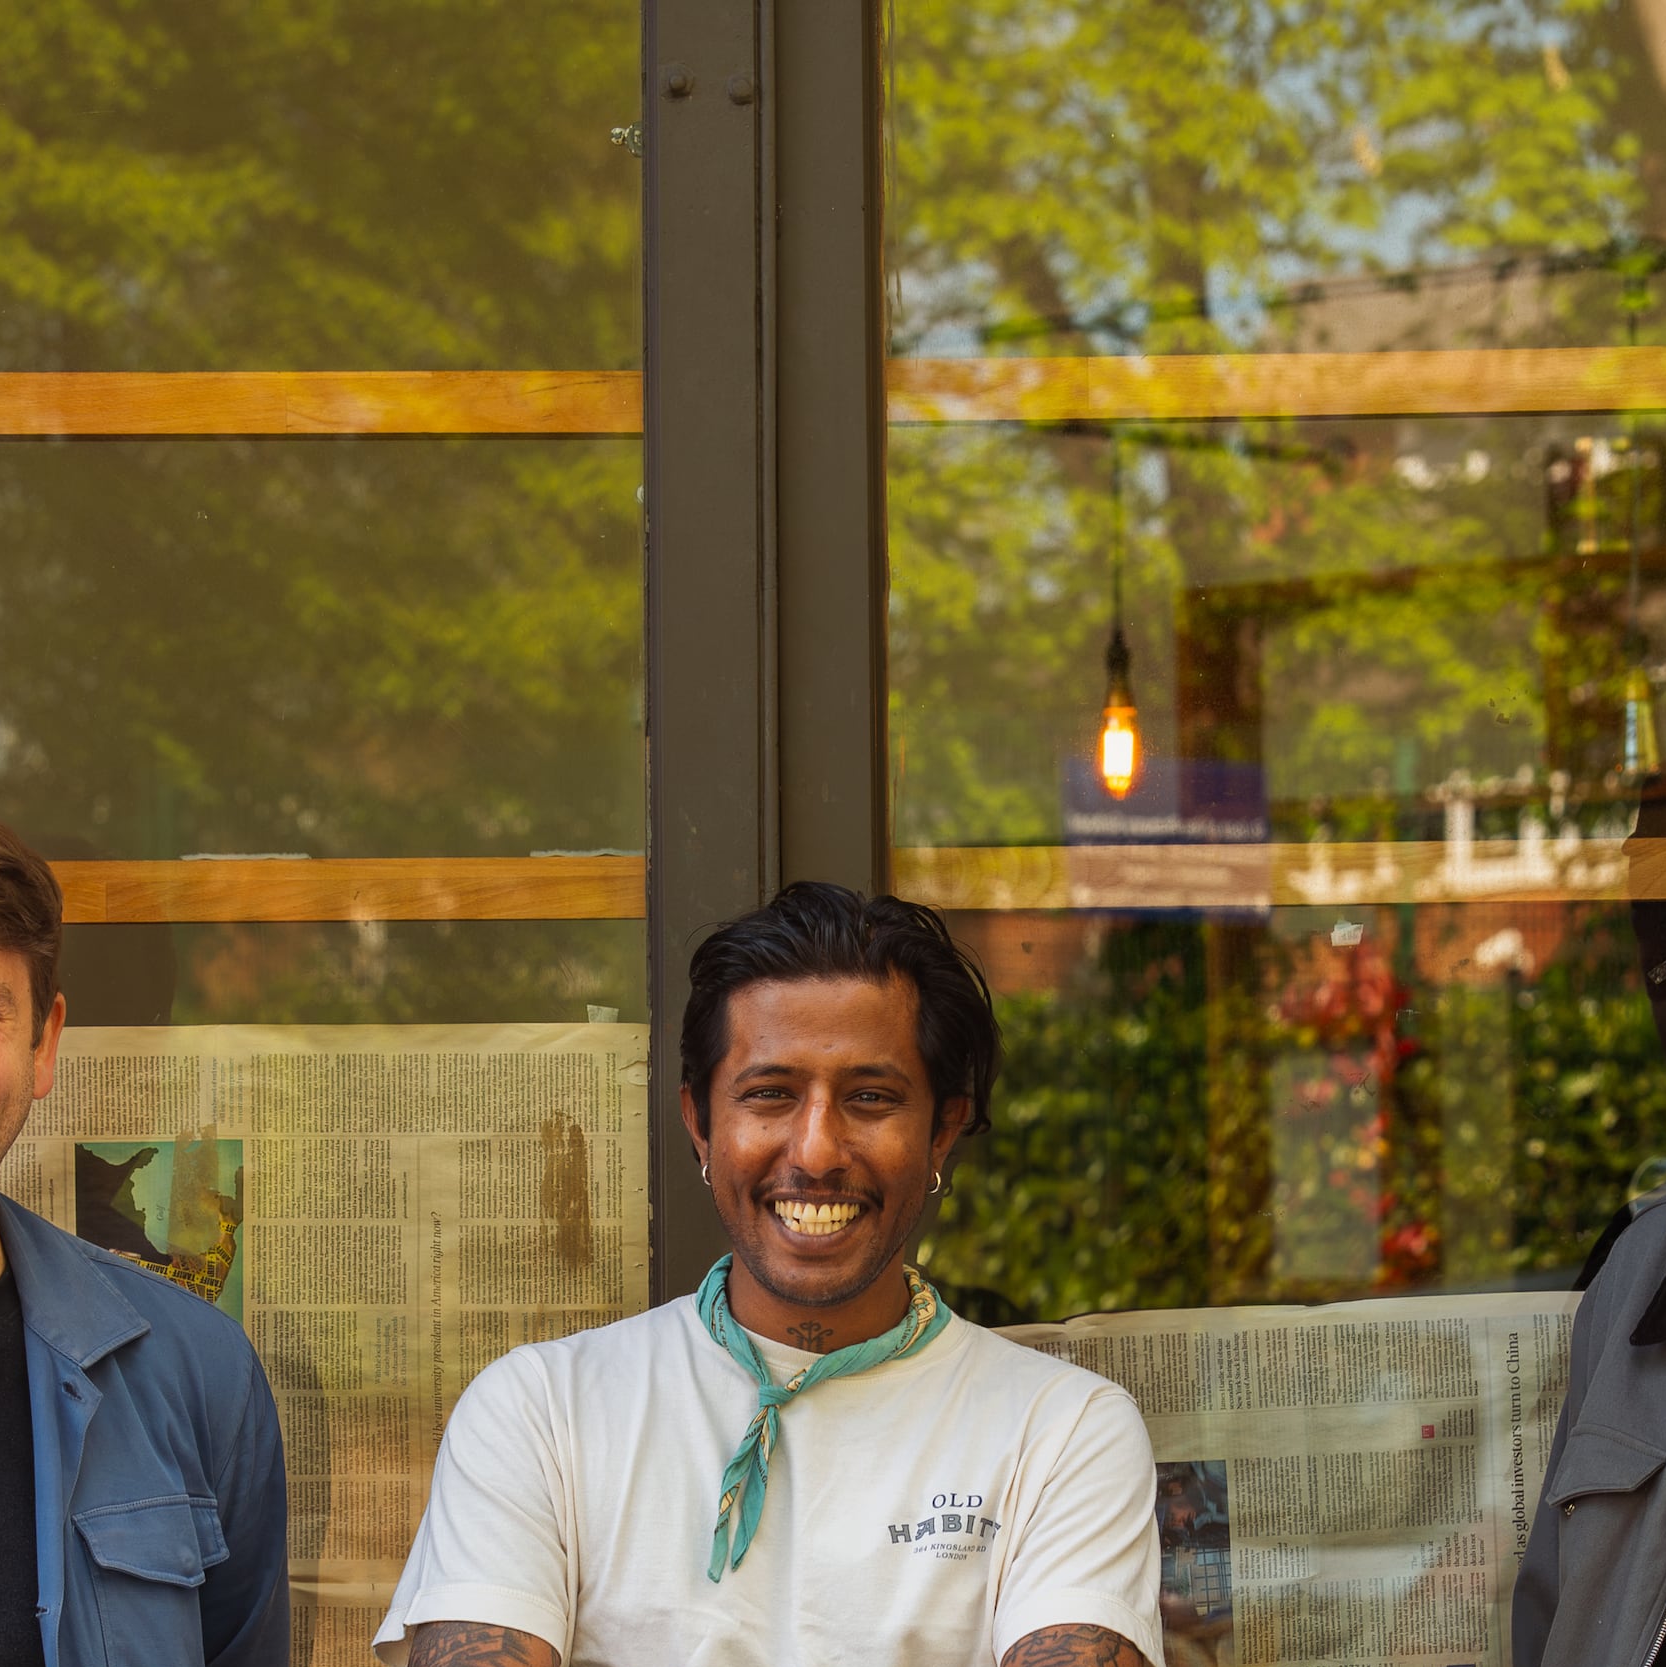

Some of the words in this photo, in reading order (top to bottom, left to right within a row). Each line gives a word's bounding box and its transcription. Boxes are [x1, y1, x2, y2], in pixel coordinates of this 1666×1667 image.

[430, 1211, 442, 1238] now?
[431, 1240, 443, 1264] right
[430, 1266, 442, 1306] America
[432, 1308, 441, 1318] in
[431, 1320, 444, 1363] president
[1506, 1332, 1520, 1374] China
[432, 1367, 444, 1411] university
[1509, 1376, 1520, 1390] to
[1511, 1393, 1522, 1422] turn
[433, 1422, 443, 1431] be
[1511, 1424, 1525, 1487] investors
[932, 1492, 983, 1509] OLD
[1511, 1490, 1528, 1532] global
[1516, 1534, 1526, 1547] as
[936, 1552, 968, 1560] LONDON
